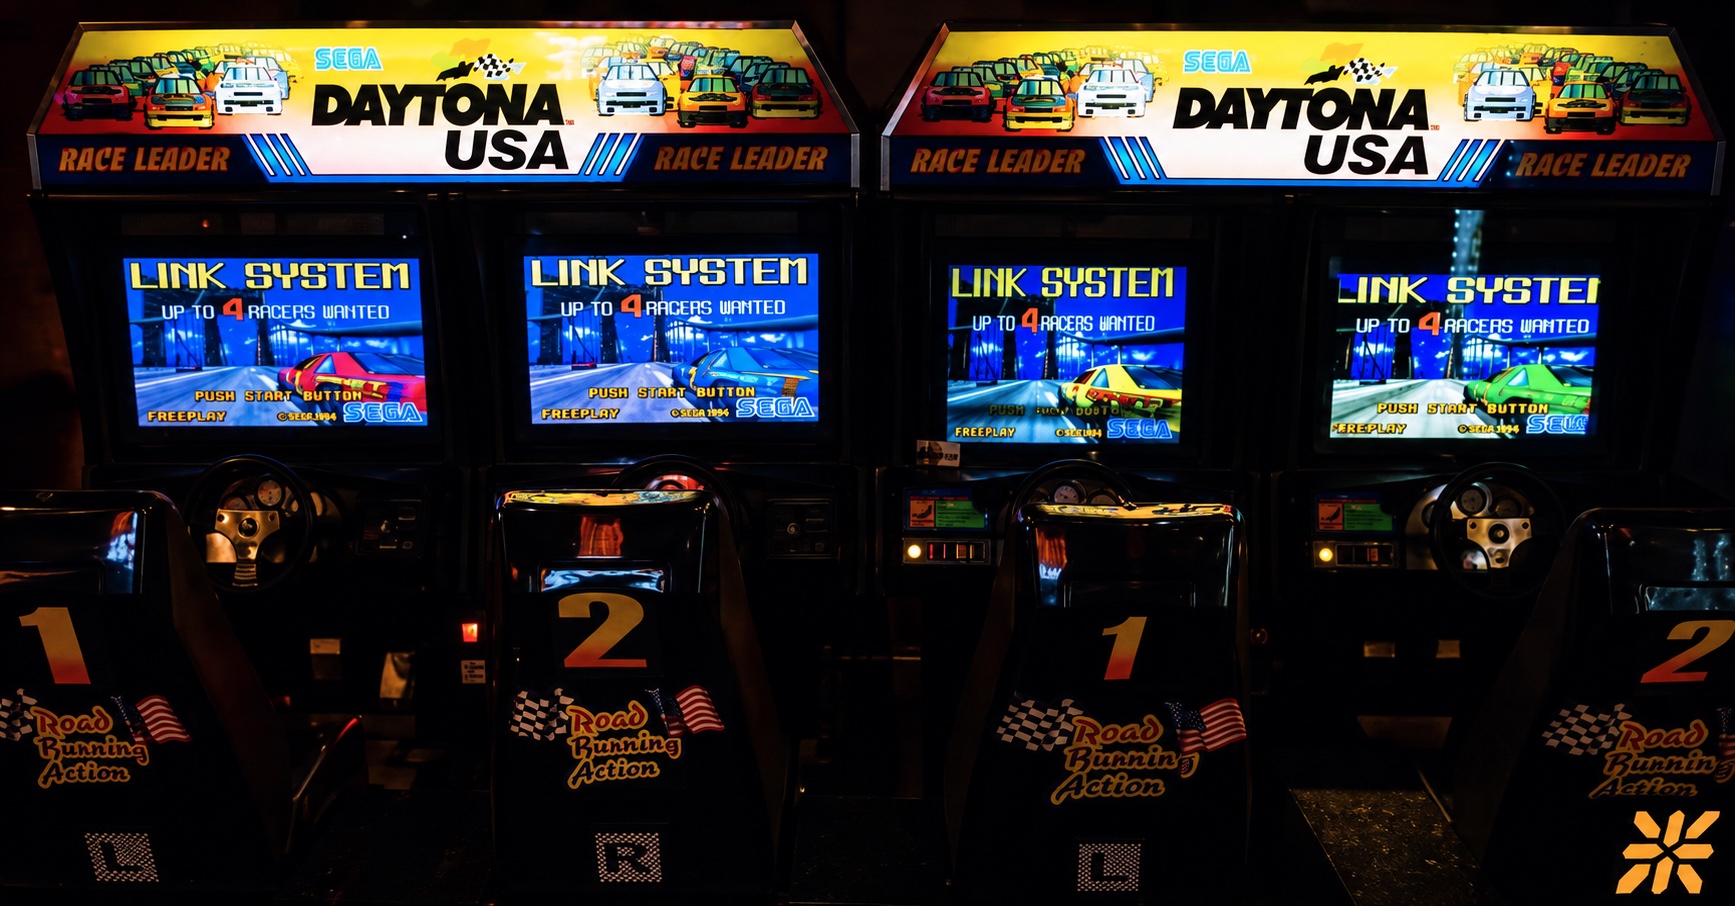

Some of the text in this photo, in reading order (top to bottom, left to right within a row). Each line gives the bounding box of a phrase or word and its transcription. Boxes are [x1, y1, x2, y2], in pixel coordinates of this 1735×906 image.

[314, 47, 382, 71] SEGA
[1184, 49, 1253, 75] SEGA
[312, 84, 565, 126] DAYTONA
[1172, 87, 1430, 131] DAYTONA
[59, 146, 230, 172] RACE LEADER
[444, 130, 569, 170] USA
[654, 147, 827, 171] RACE LEADER
[910, 148, 1086, 174] RACE LEADER
[1302, 134, 1429, 175] USA
[1515, 153, 1692, 178] RACE LEADER
[130, 262, 410, 289] LINK SYSTEM
[531, 257, 807, 286] LINK SYSTEM
[951, 267, 1174, 298] LINK SYSTEM
[162, 298, 389, 320] UP TO 4 RACERS WANTED
[561, 294, 785, 317] UP TO 4 RACERS WANTED
[973, 307, 1155, 333] UP TO 4 RACERS WANTED
[1356, 312, 1590, 336] UP TO 4 RACERS WANTED
[195, 390, 362, 401] PUSH START BUTTON
[589, 387, 755, 399] PUSH START BUTTON
[147, 411, 226, 422] FREEPLAY
[343, 402, 423, 422] SEGA
[541, 408, 620, 419] FREEPLAY
[736, 397, 815, 418] SEGA
[1377, 403, 1549, 414] PUSH START BUTTON
[955, 427, 1015, 438] FREEPLAY
[1107, 418, 1172, 439] SEGA
[558, 592, 647, 667] 2
[19, 606, 91, 684] 1
[1102, 616, 1147, 680] 1
[1640, 620, 1735, 683] 2
[30, 705, 113, 736] Road
[566, 700, 648, 733] Road
[1072, 714, 1164, 748] Road
[1615, 719, 1709, 752] Road
[33, 734, 149, 766] Running
[567, 730, 681, 759] Running
[38, 759, 131, 789] Action
[567, 756, 660, 789] Action
[1051, 771, 1166, 805] Action
[1588, 777, 1698, 799] Action
